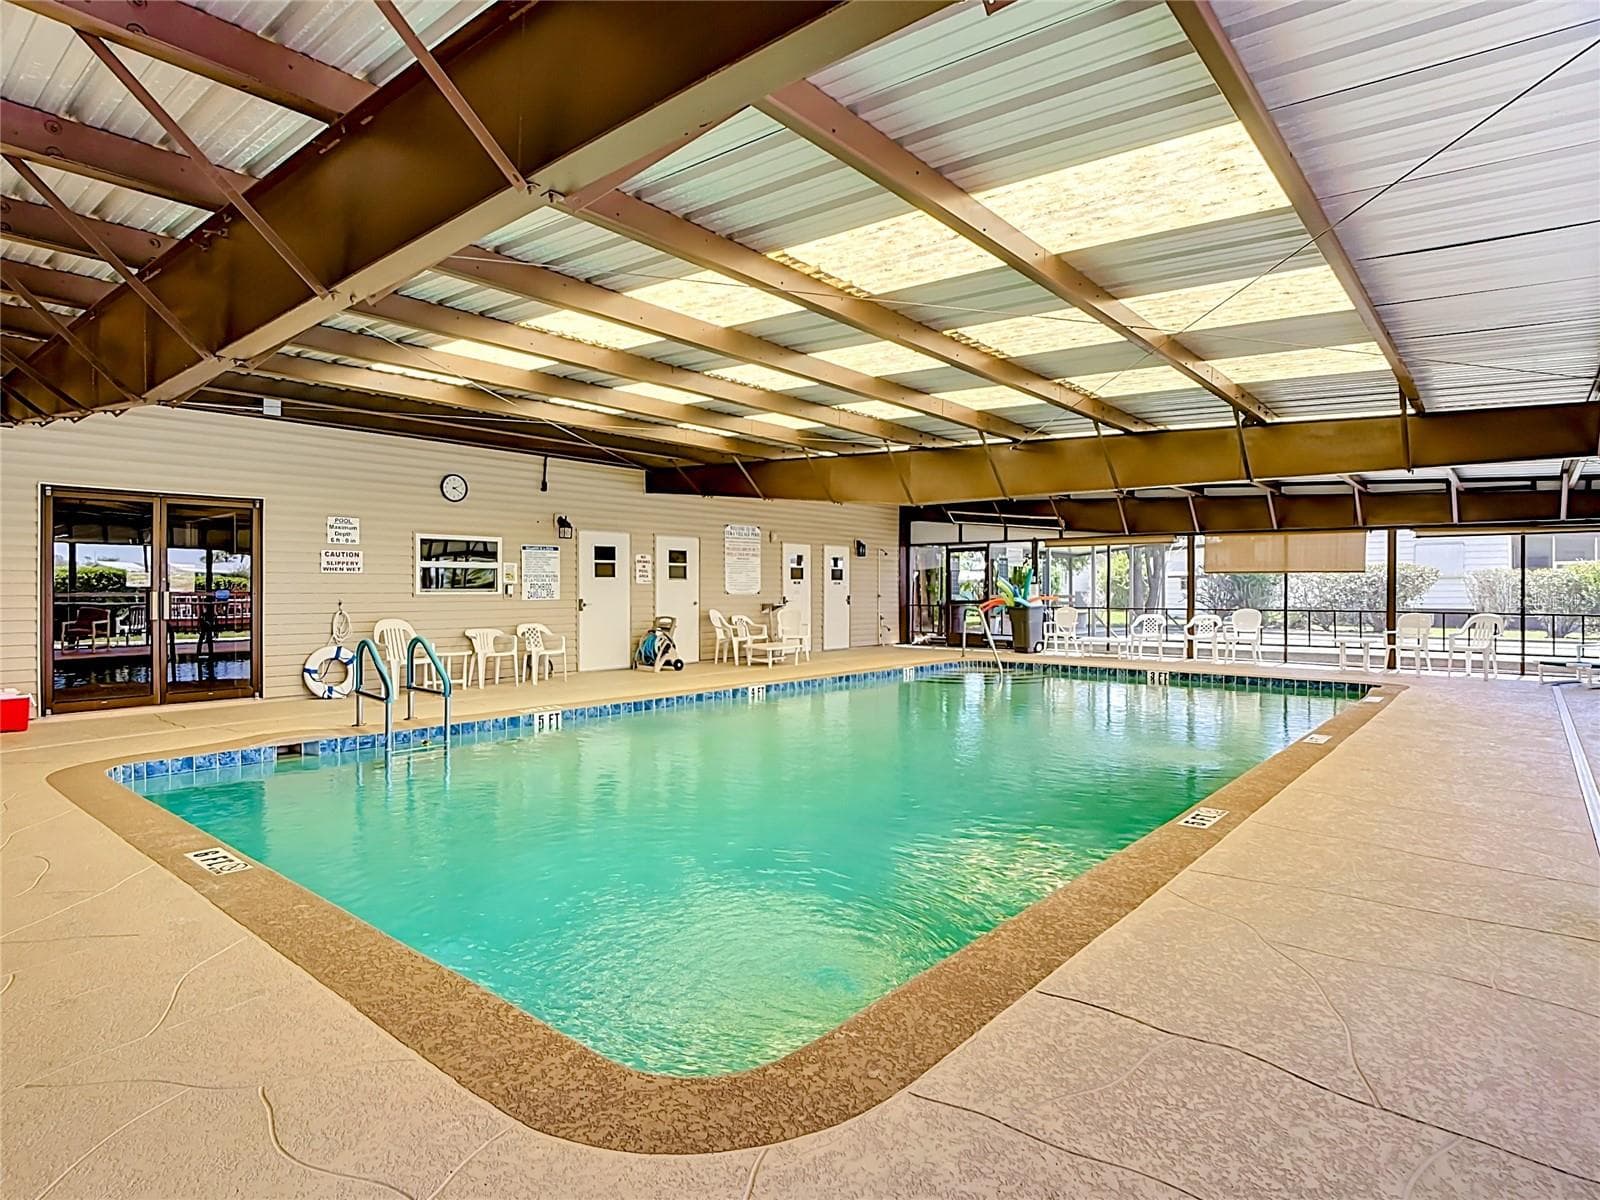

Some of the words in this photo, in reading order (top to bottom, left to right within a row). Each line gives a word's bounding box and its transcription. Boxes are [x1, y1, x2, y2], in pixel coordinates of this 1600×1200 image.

[334, 517, 353, 525] POOL
[1158, 671, 1168, 685] FT
[548, 712, 560, 730] FT
